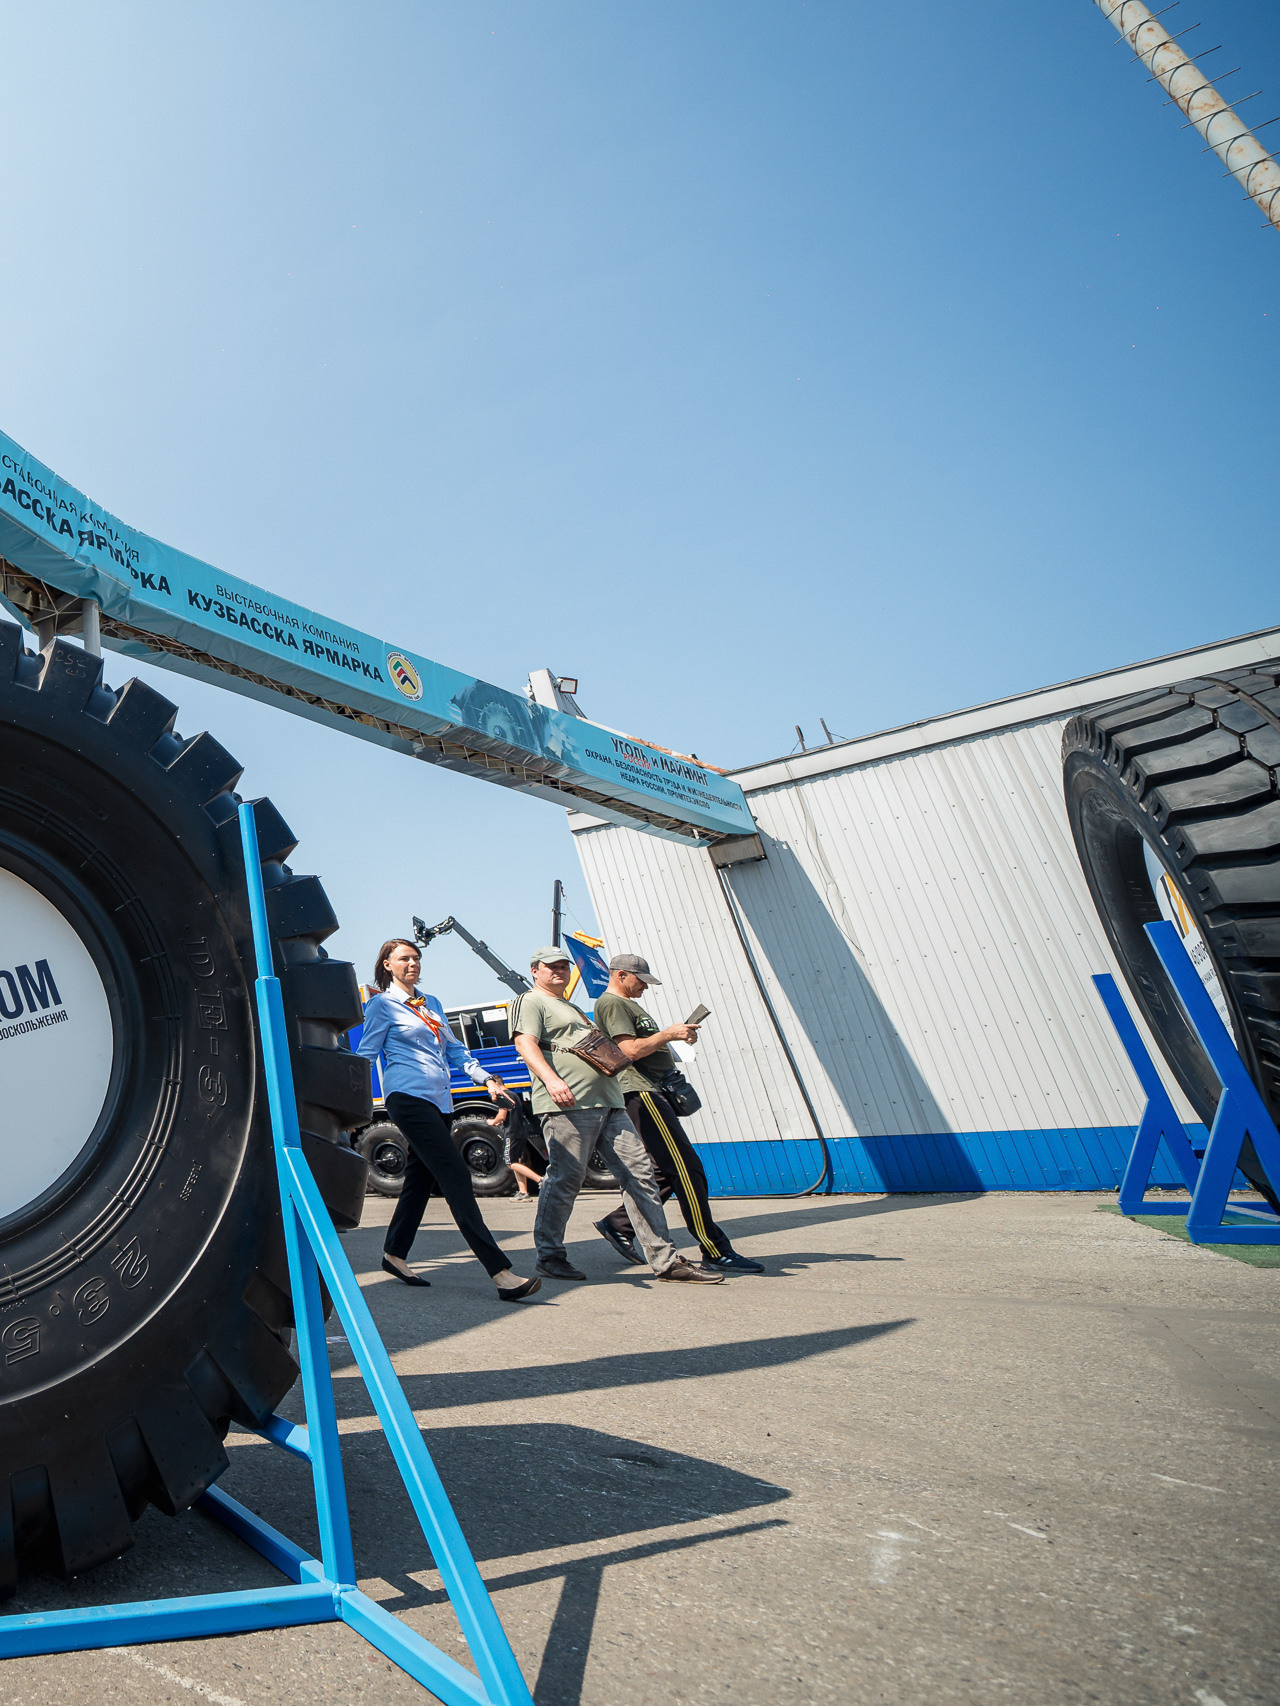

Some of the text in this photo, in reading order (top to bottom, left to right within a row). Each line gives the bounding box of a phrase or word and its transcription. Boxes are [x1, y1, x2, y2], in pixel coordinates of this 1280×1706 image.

[216, 584, 360, 654] ВЫСТАВОЧНАЯ КОМПАНИЯ
[188, 588, 299, 651] КУЗБАССКА
[302, 638, 384, 684] ЯРМАРКА
[585, 748, 614, 768] ОХРАНА,
[615, 760, 663, 783] БЕЗОПАСНОСТЬ
[623, 753, 652, 770] РОССИИ
[660, 756, 708, 787] МАЙНИНГ
[620, 772, 641, 786] НЕДРА
